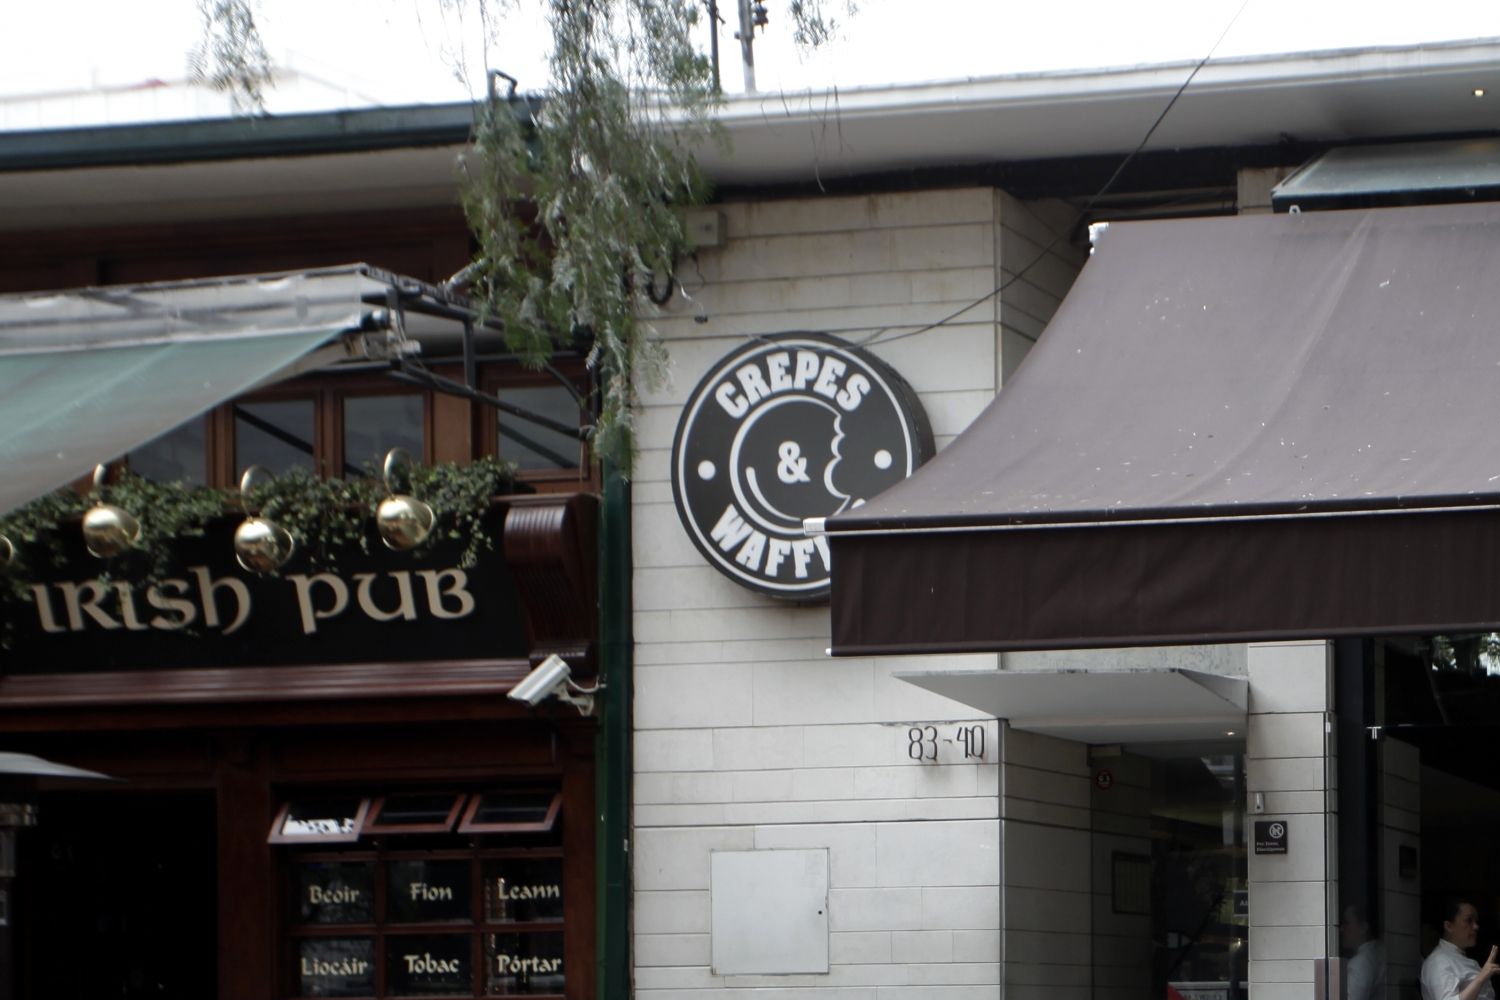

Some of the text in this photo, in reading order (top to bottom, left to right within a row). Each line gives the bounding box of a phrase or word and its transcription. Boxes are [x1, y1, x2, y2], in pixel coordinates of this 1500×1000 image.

[715, 350, 871, 419] CREPES
[777, 441, 811, 484] &
[710, 503, 831, 578] WAFF
[908, 725, 985, 760] 83-40
[403, 952, 460, 974] Tobac
